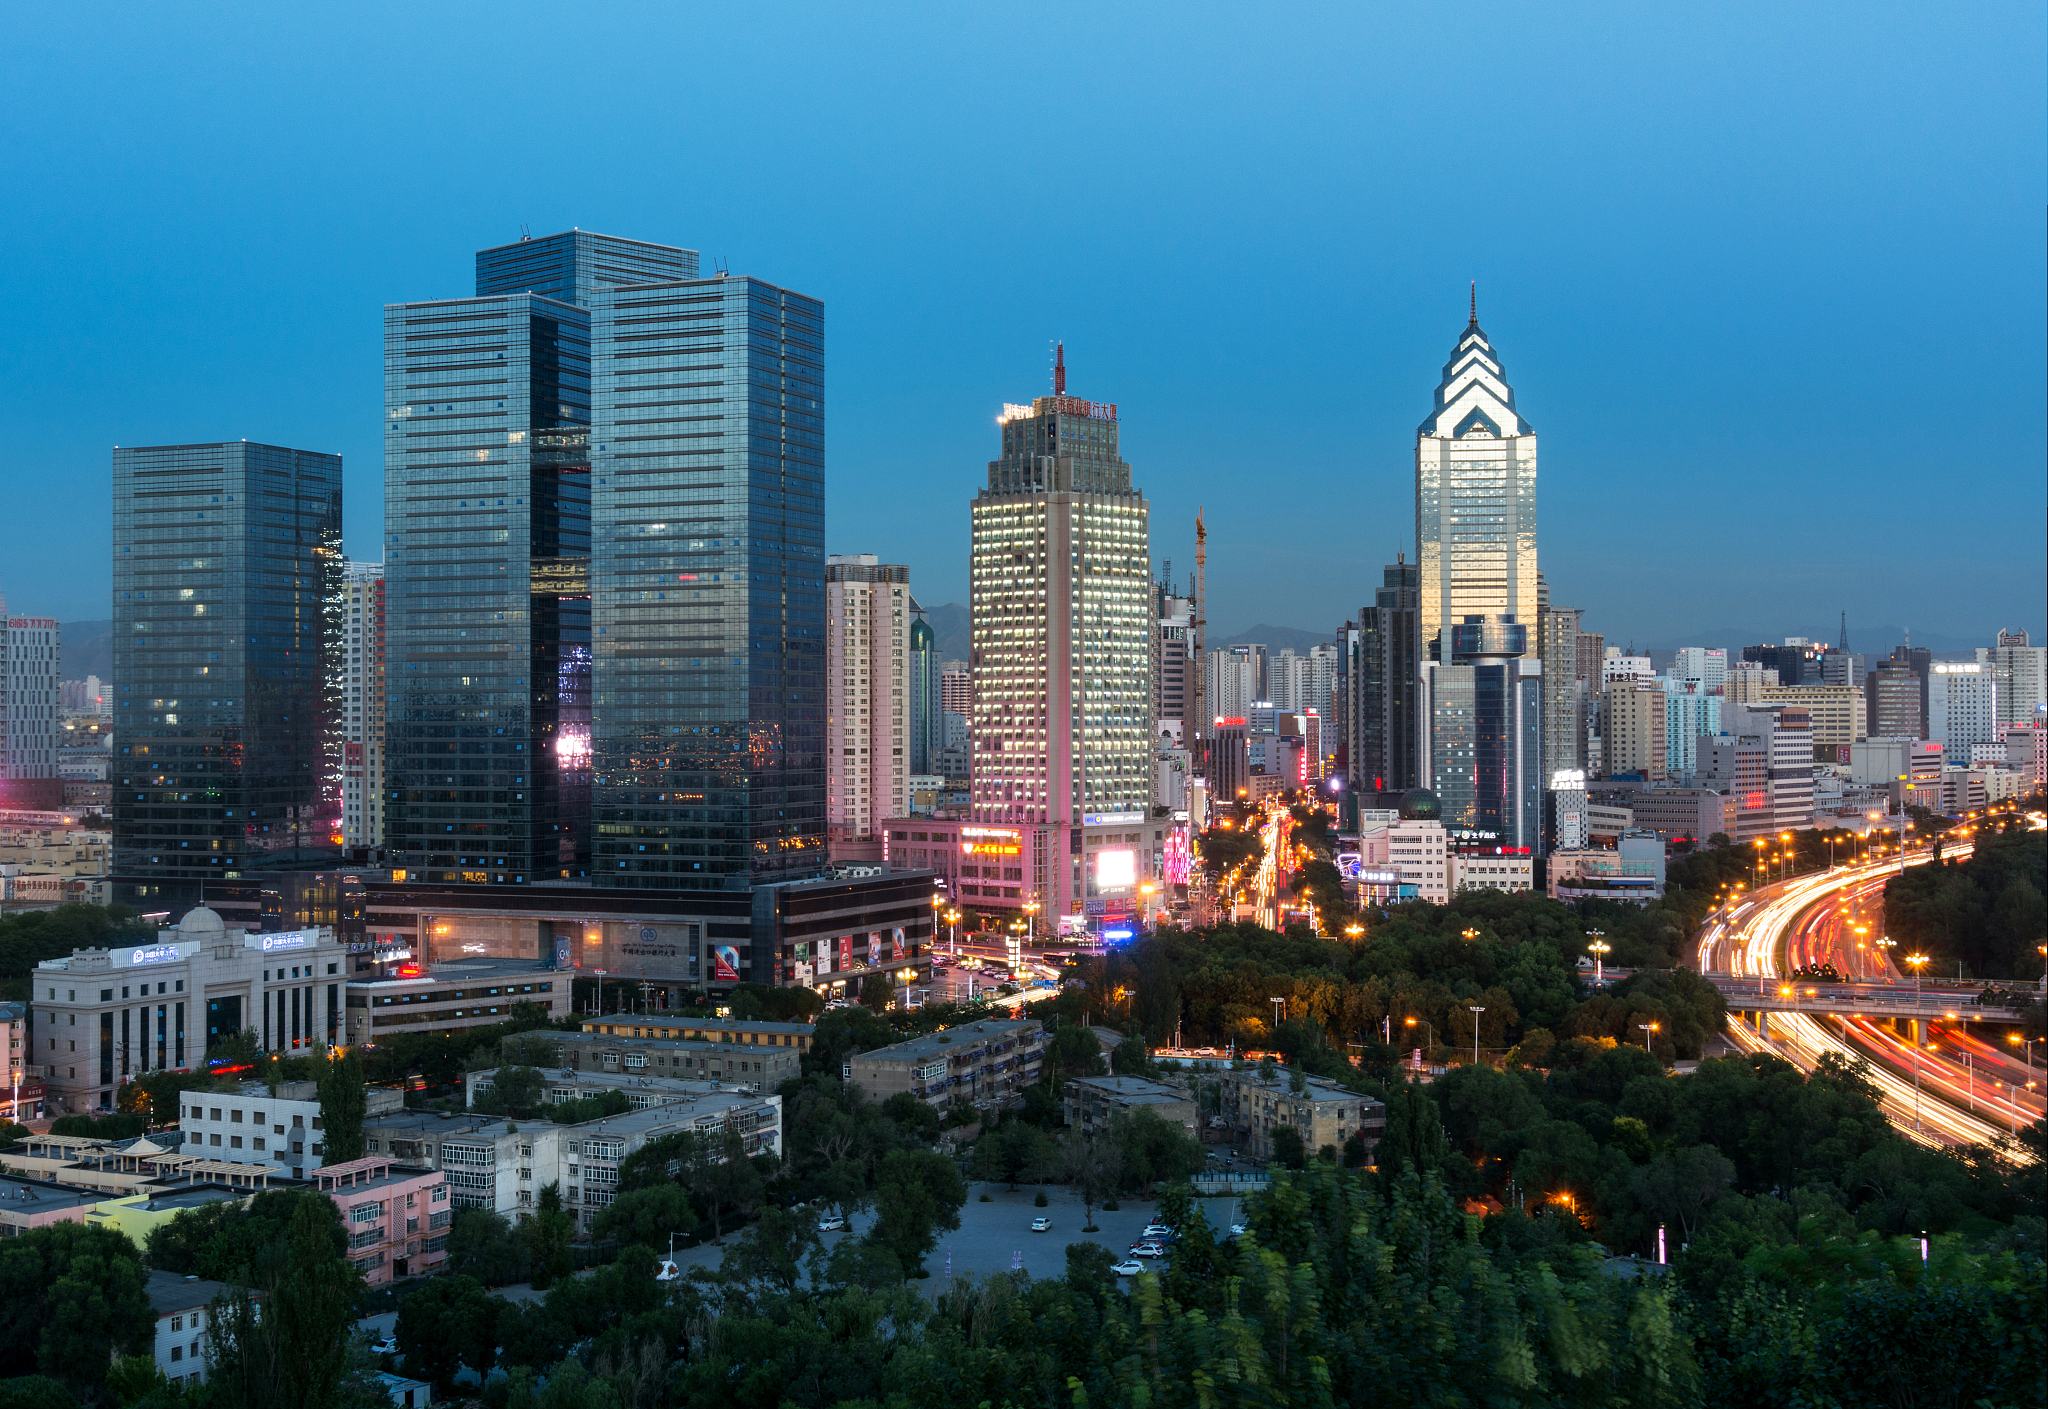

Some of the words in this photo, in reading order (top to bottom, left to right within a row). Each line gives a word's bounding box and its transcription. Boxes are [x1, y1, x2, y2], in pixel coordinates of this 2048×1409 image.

[1057, 398, 1118, 420] 市商业银行大厦
[9, 618, 54, 629] 6657777
